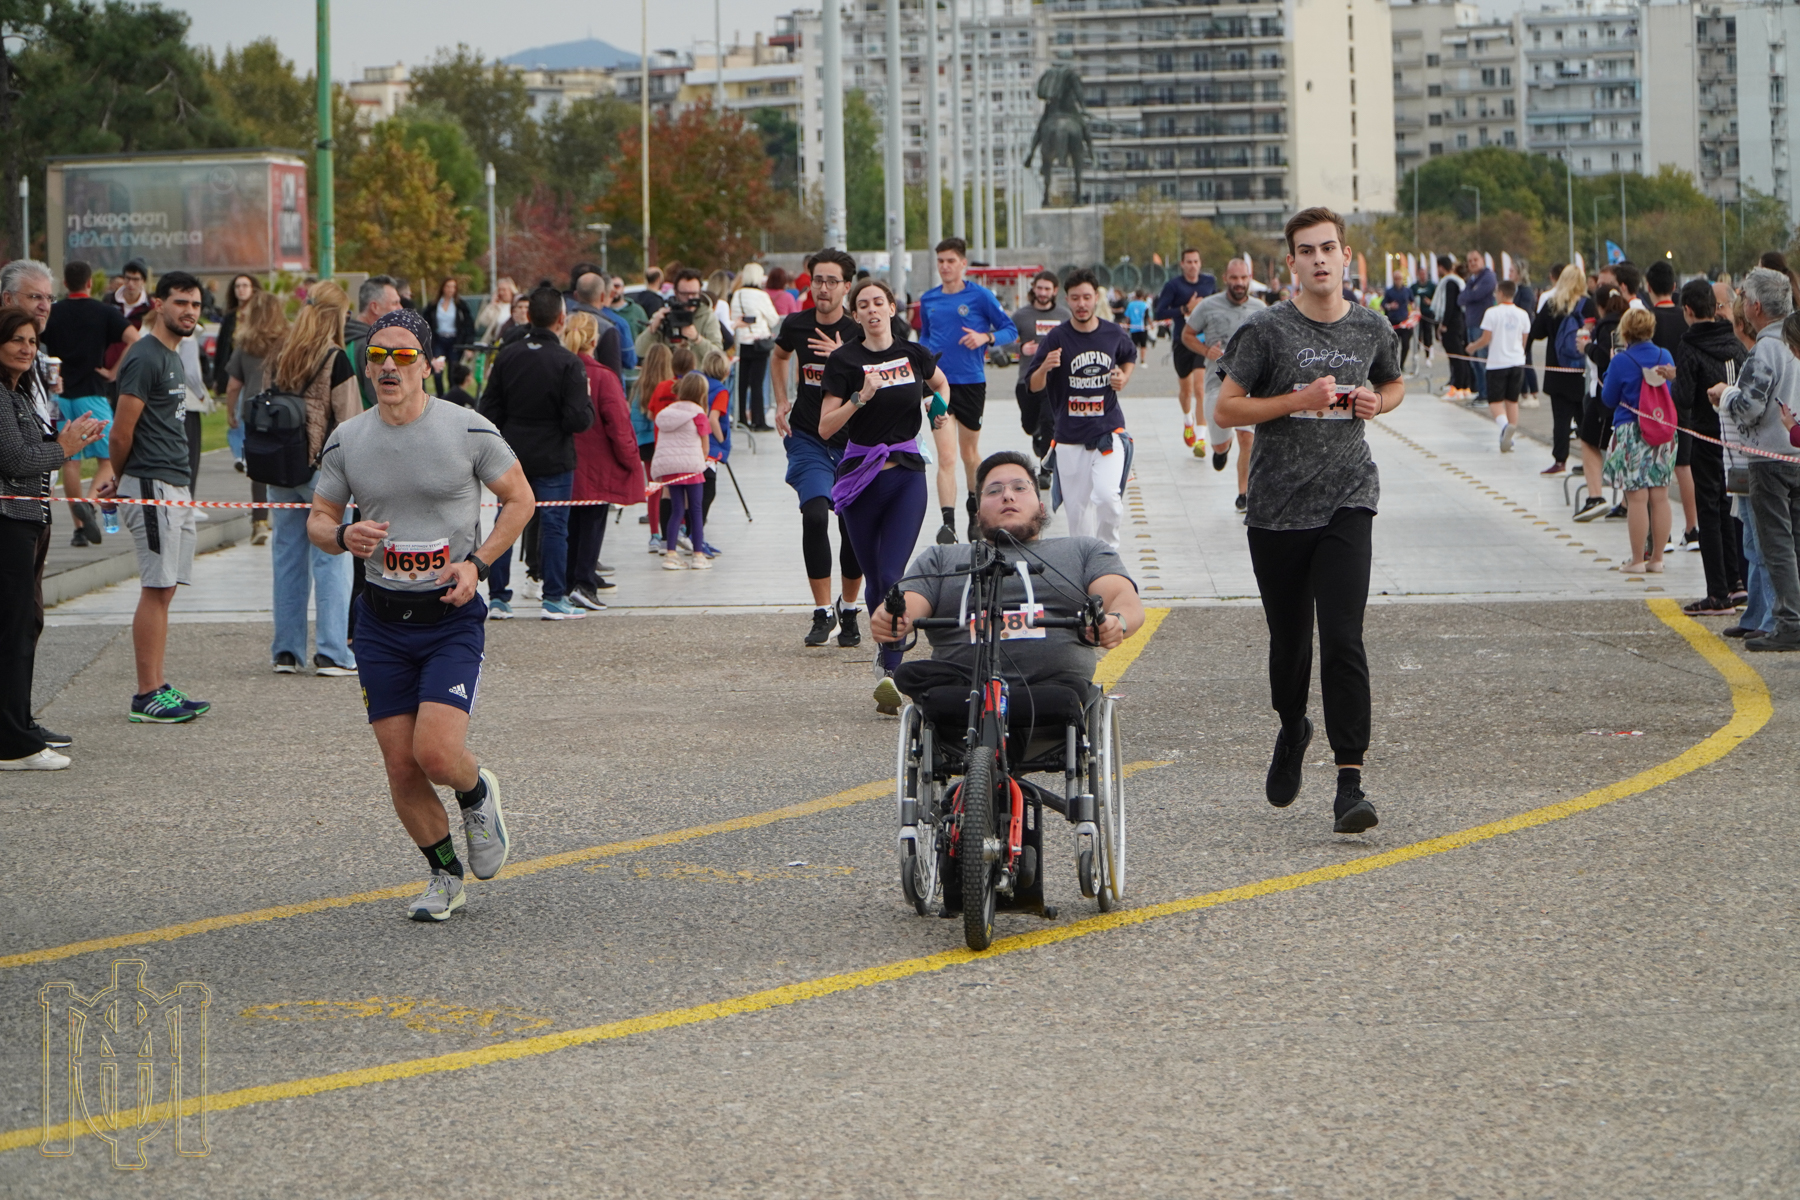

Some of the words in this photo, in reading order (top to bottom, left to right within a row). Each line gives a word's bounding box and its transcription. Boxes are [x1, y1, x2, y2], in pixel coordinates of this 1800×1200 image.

[67, 213, 80, 231] η
[83, 209, 168, 231] έκφραση
[69, 230, 117, 248] θέλει
[120, 227, 203, 249] ενέργεια
[869, 365, 909, 381] 078
[1070, 402, 1102, 412] 0013
[385, 549, 446, 572] 0695
